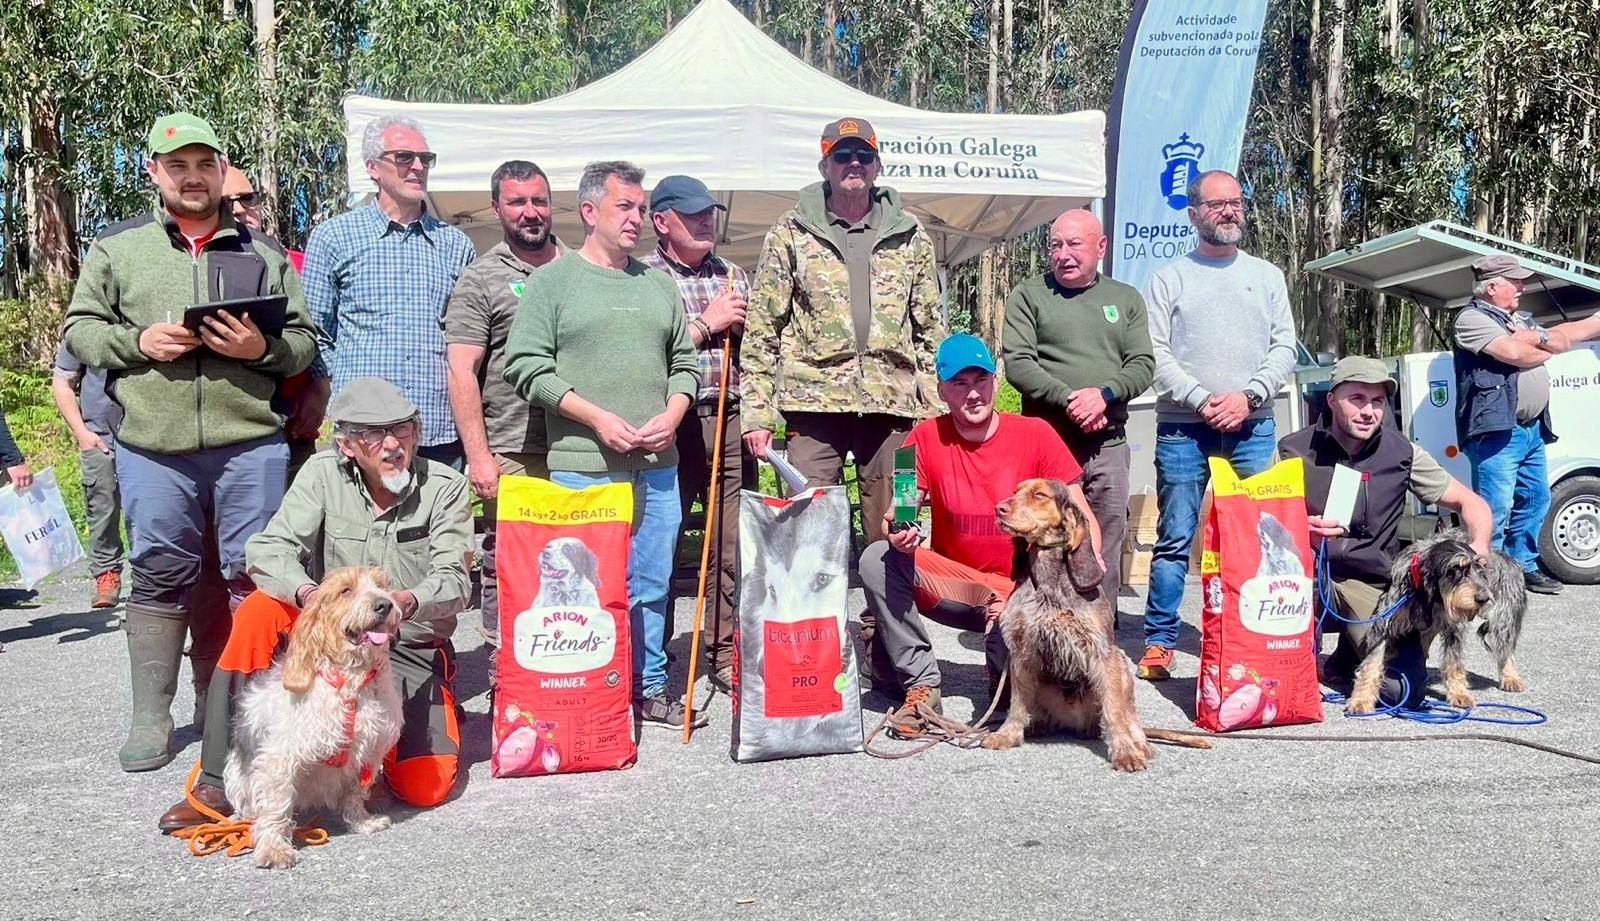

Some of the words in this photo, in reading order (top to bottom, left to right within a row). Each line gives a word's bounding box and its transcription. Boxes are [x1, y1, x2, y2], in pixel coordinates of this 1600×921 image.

[1175, 14, 1238, 26] Actividade
[1148, 28, 1234, 42] subvencionada
[1140, 46, 1205, 60] Deputación
[1208, 46, 1222, 55] da
[878, 136, 953, 155] ración
[959, 137, 1038, 162] Galega
[918, 163, 947, 178] na
[953, 160, 1039, 181] Coruña
[1123, 243, 1147, 260] DA
[1549, 374, 1589, 391] alega
[1256, 484, 1293, 496] GRATIS
[518, 507, 531, 517] 14
[570, 508, 617, 521] GRATIS
[1268, 579, 1300, 594] ARION
[543, 611, 588, 627] ARION
[530, 629, 607, 657] Friends
[1266, 639, 1301, 650] WINNER
[540, 677, 588, 689] WINNER
[792, 675, 818, 688] PRO
[555, 698, 586, 706] ADULT
